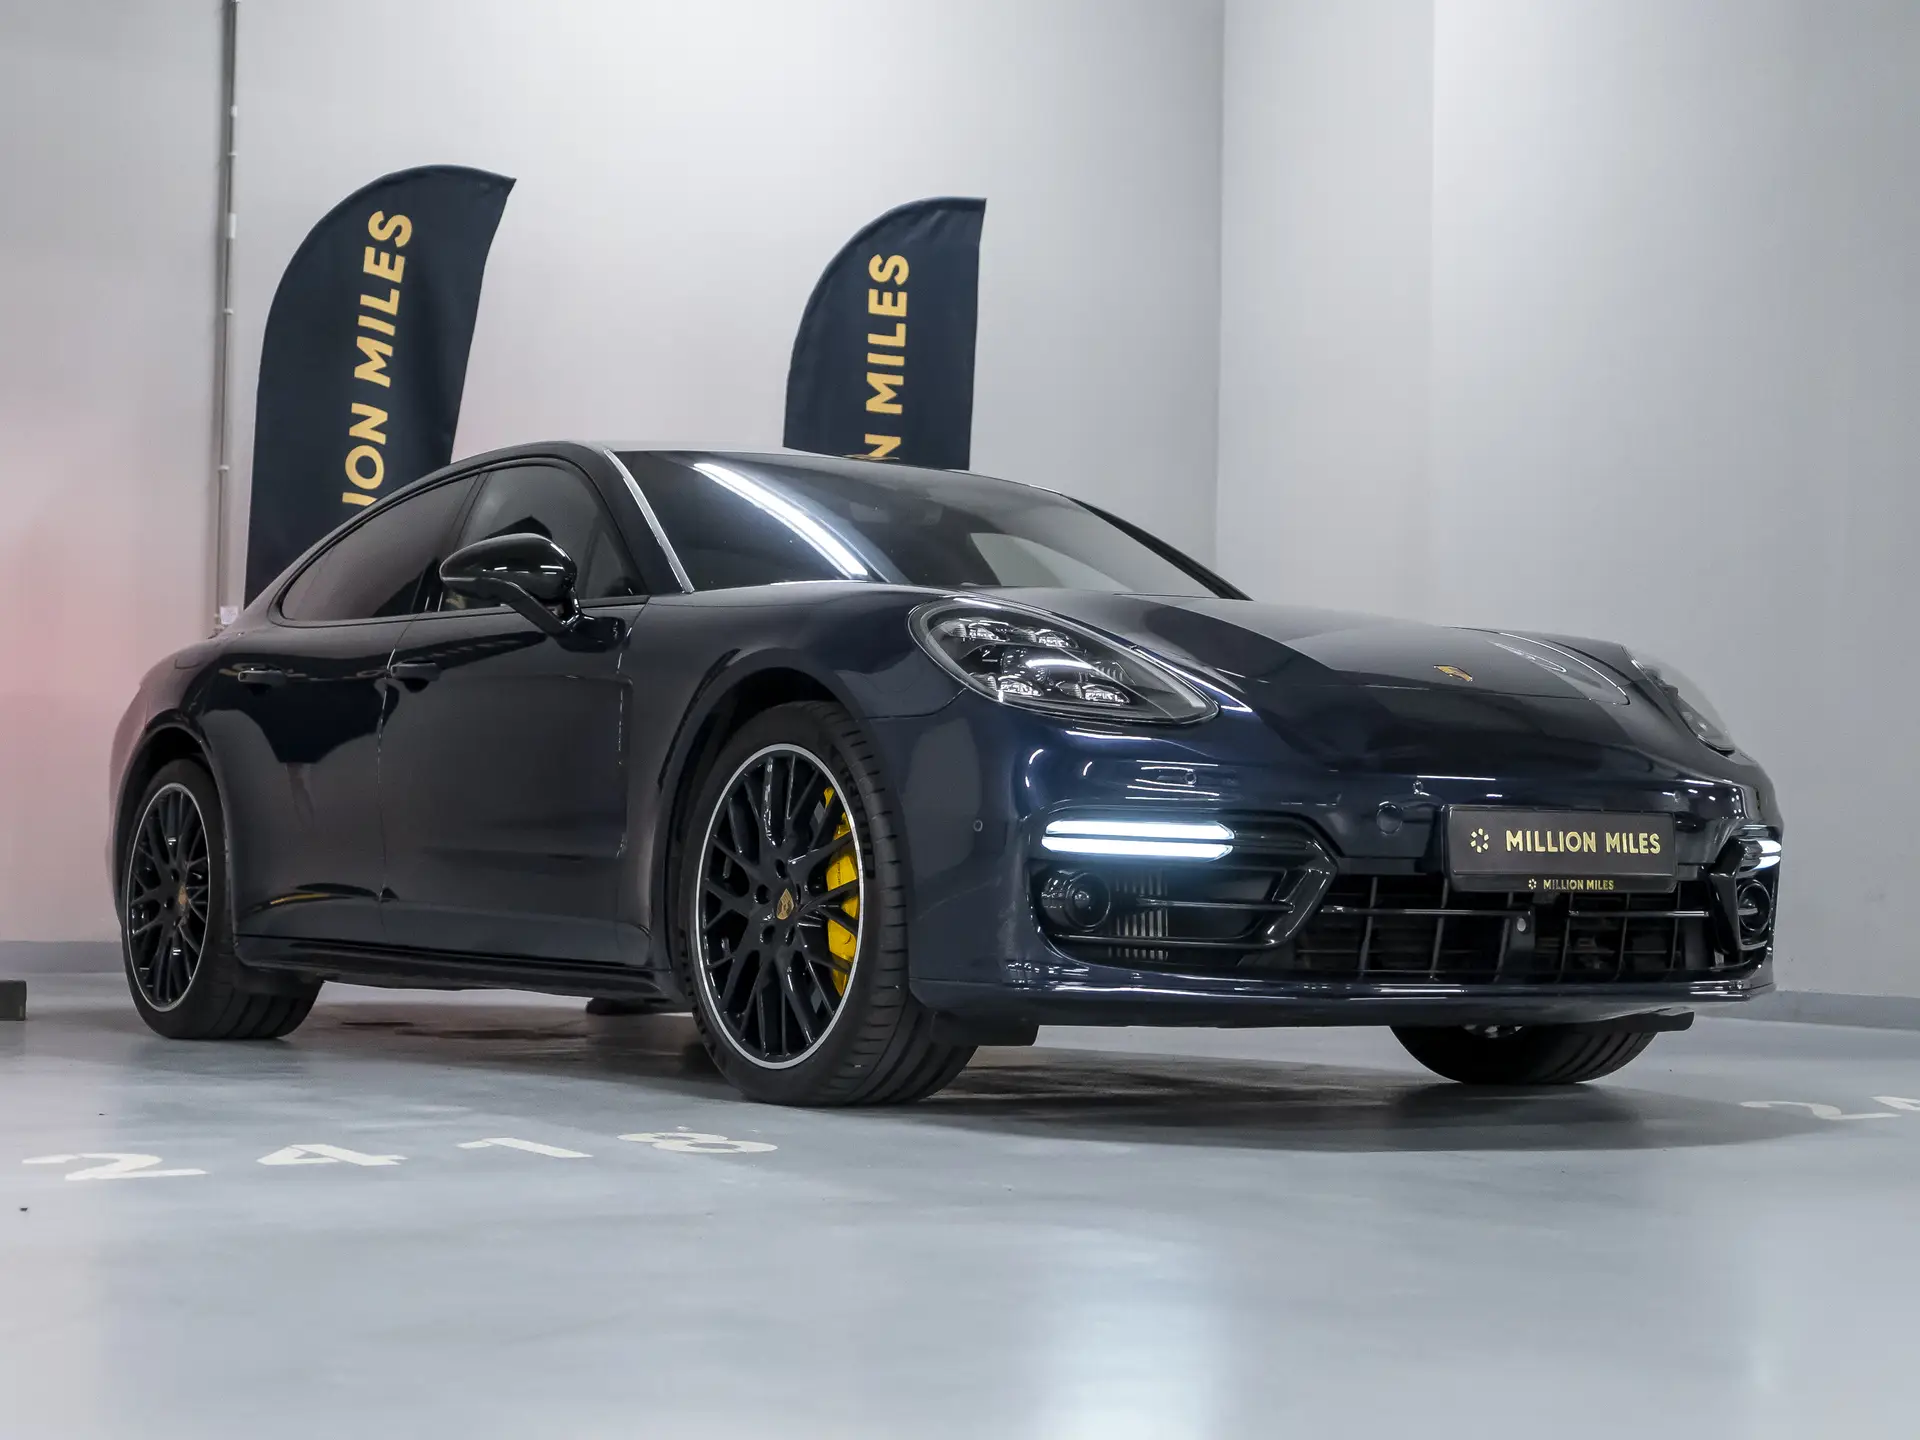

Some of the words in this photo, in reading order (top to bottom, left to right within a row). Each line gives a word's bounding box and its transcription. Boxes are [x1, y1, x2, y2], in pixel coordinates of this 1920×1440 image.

[354, 210, 412, 388] MILES
[866, 254, 909, 415] MILES
[1506, 829, 1597, 853] MILLION
[1605, 832, 1661, 855] MILES
[1543, 879, 1584, 891] MILLION
[1586, 879, 1614, 891] MILES
